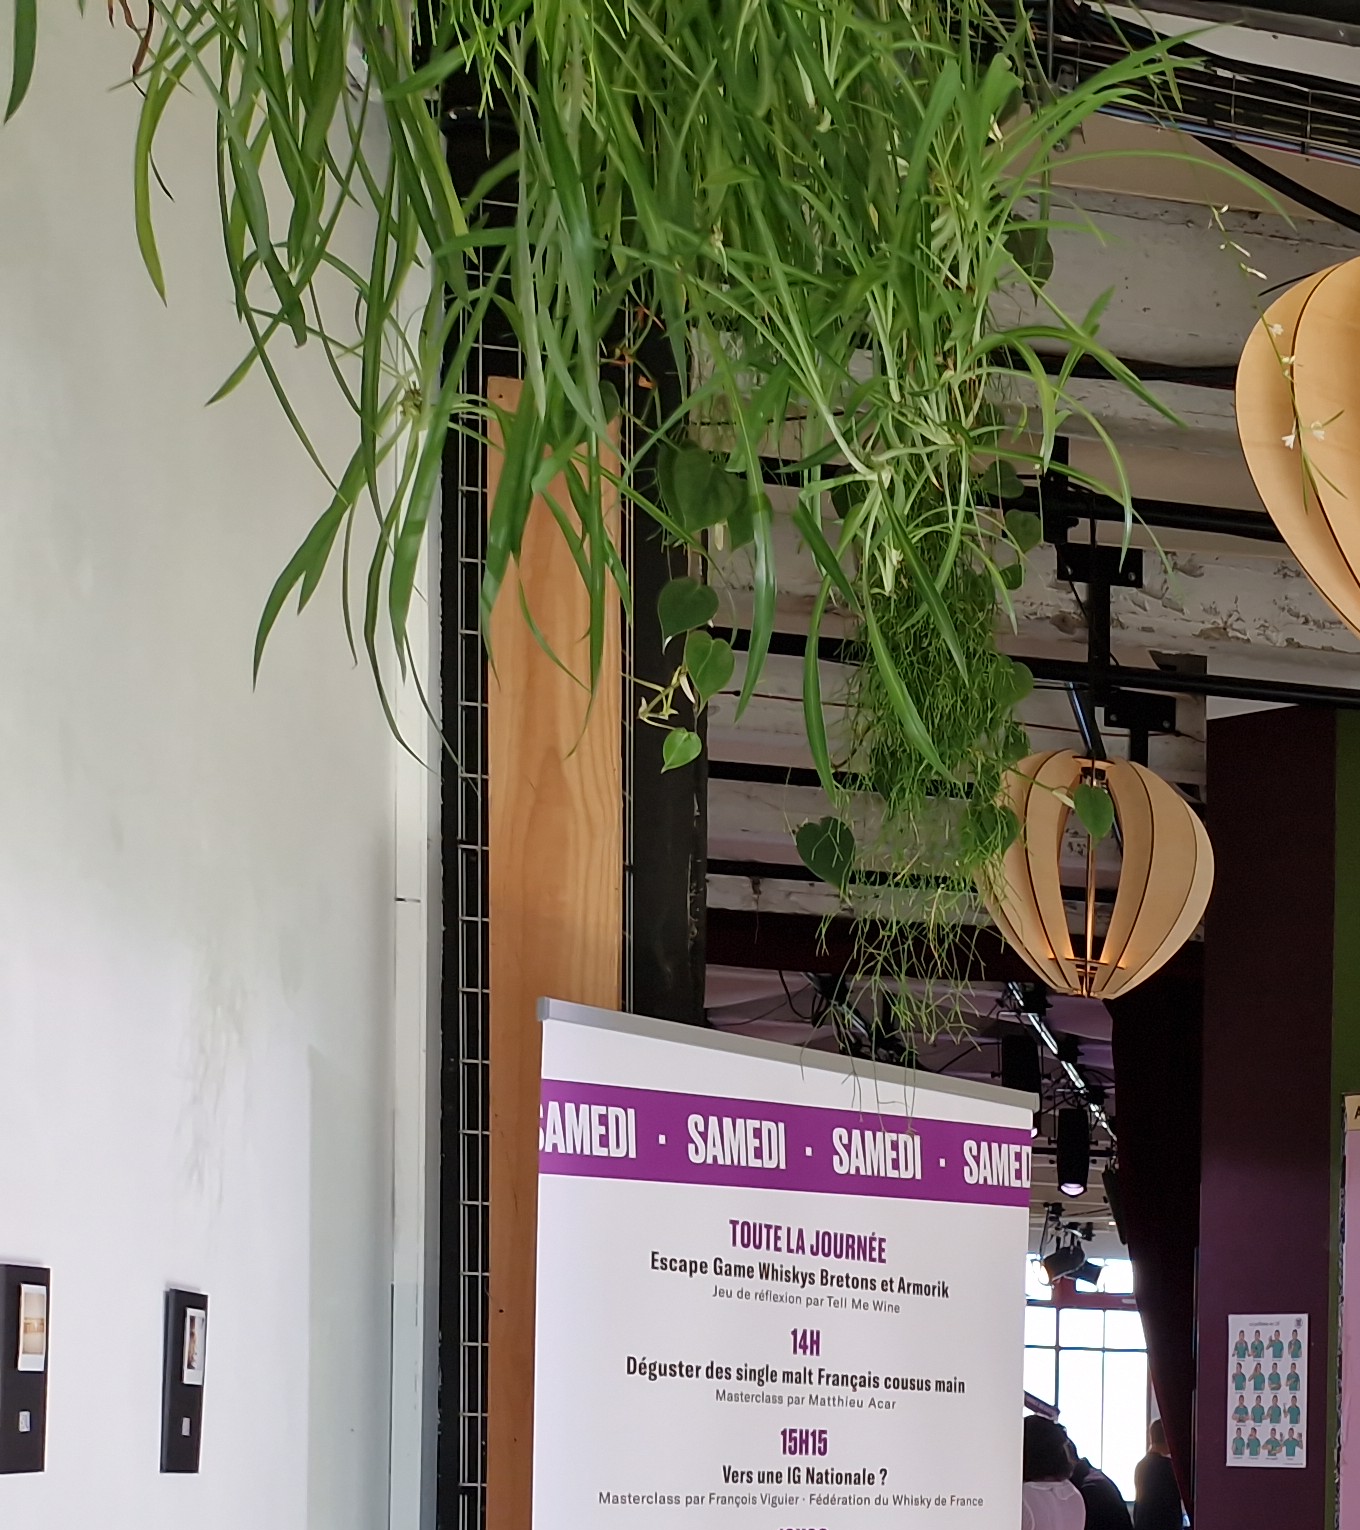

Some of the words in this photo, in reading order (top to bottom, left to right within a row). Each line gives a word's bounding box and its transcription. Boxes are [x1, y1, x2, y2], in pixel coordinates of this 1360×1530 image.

[688, 1114, 786, 1169] SAMEDI
[833, 1128, 921, 1179] SAMEDI
[729, 1220, 782, 1252] TOUTE
[787, 1227, 805, 1255] LA
[810, 1230, 886, 1263] JOURNÉE
[651, 1251, 708, 1278] Escape
[714, 1257, 754, 1279] Game
[759, 1262, 815, 1288] Whiskys
[821, 1269, 876, 1291] Bretons
[881, 1277, 894, 1293] et
[898, 1277, 949, 1298] Armorik
[713, 1285, 732, 1298] Jeu
[737, 1287, 750, 1300] de
[755, 1290, 801, 1304] réflexion
[806, 1297, 824, 1308] par
[827, 1296, 846, 1308] Tell
[852, 1298, 869, 1310] Me
[873, 1300, 900, 1313] Wine
[791, 1328, 820, 1356] 14H
[627, 1356, 701, 1381] Déguster
[706, 1361, 731, 1380] des
[736, 1363, 777, 1386] single
[782, 1367, 813, 1385] malt
[818, 1368, 879, 1392] Français
[884, 1376, 931, 1391] cousus
[935, 1377, 964, 1393] main
[716, 1389, 783, 1404] Masterclass
[788, 1396, 805, 1407] par
[809, 1394, 863, 1408] Matthieu
[868, 1397, 896, 1409] Acar
[781, 1428, 827, 1456] 15H15
[723, 1465, 753, 1483] Vers
[758, 1471, 782, 1484] une
[788, 1467, 801, 1484] IG
[806, 1467, 875, 1485] Nationale
[879, 1468, 888, 1486] ?
[599, 1492, 680, 1504] Masterclass
[686, 1496, 705, 1507] par
[709, 1493, 757, 1508] François
[760, 1493, 799, 1508] Viguier
[810, 1494, 870, 1505] Fédération
[875, 1494, 888, 1505] du
[893, 1494, 931, 1509] Whisky
[935, 1495, 946, 1506] de
[950, 1495, 983, 1506] France
